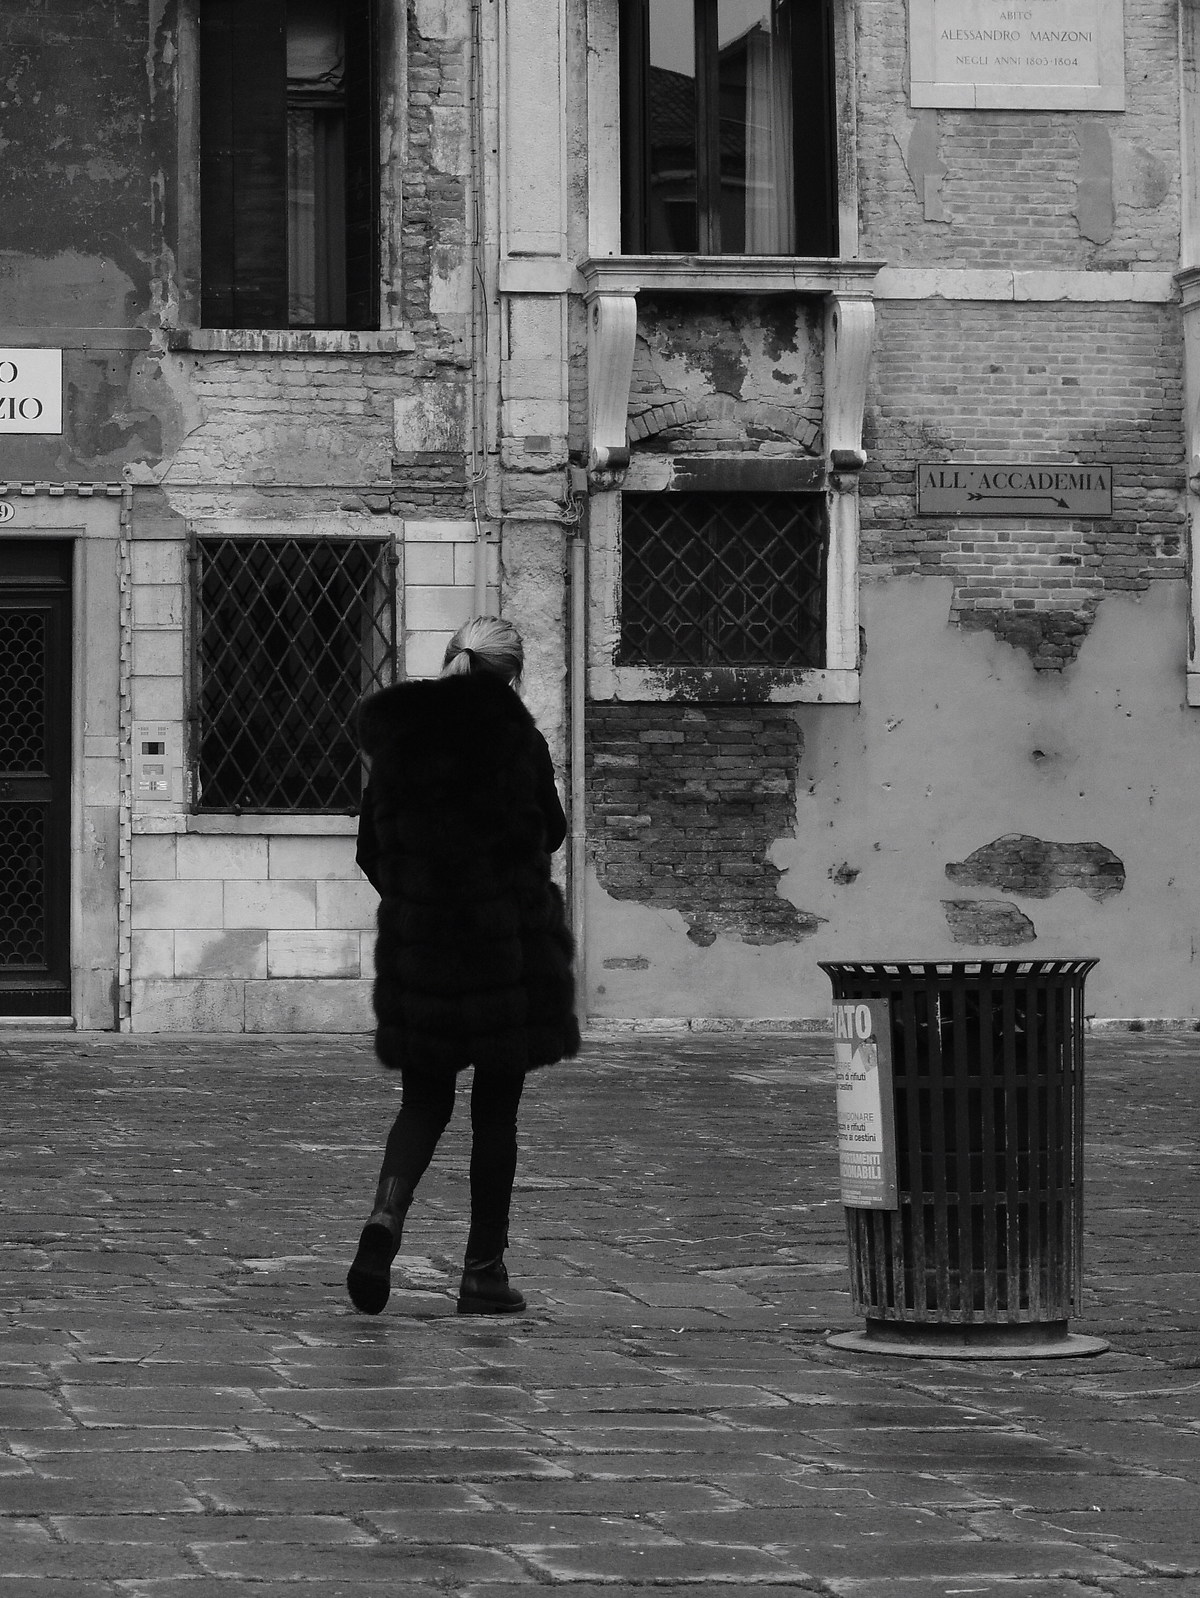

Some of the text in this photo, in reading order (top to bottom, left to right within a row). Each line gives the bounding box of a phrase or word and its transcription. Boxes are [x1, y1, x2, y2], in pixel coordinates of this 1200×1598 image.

[940, 29, 1093, 43] ALESSANDRO MANZONI
[955, 55, 989, 66] NEGLI
[993, 56, 1021, 66] ANNI
[854, 1133, 877, 1142] cestini
